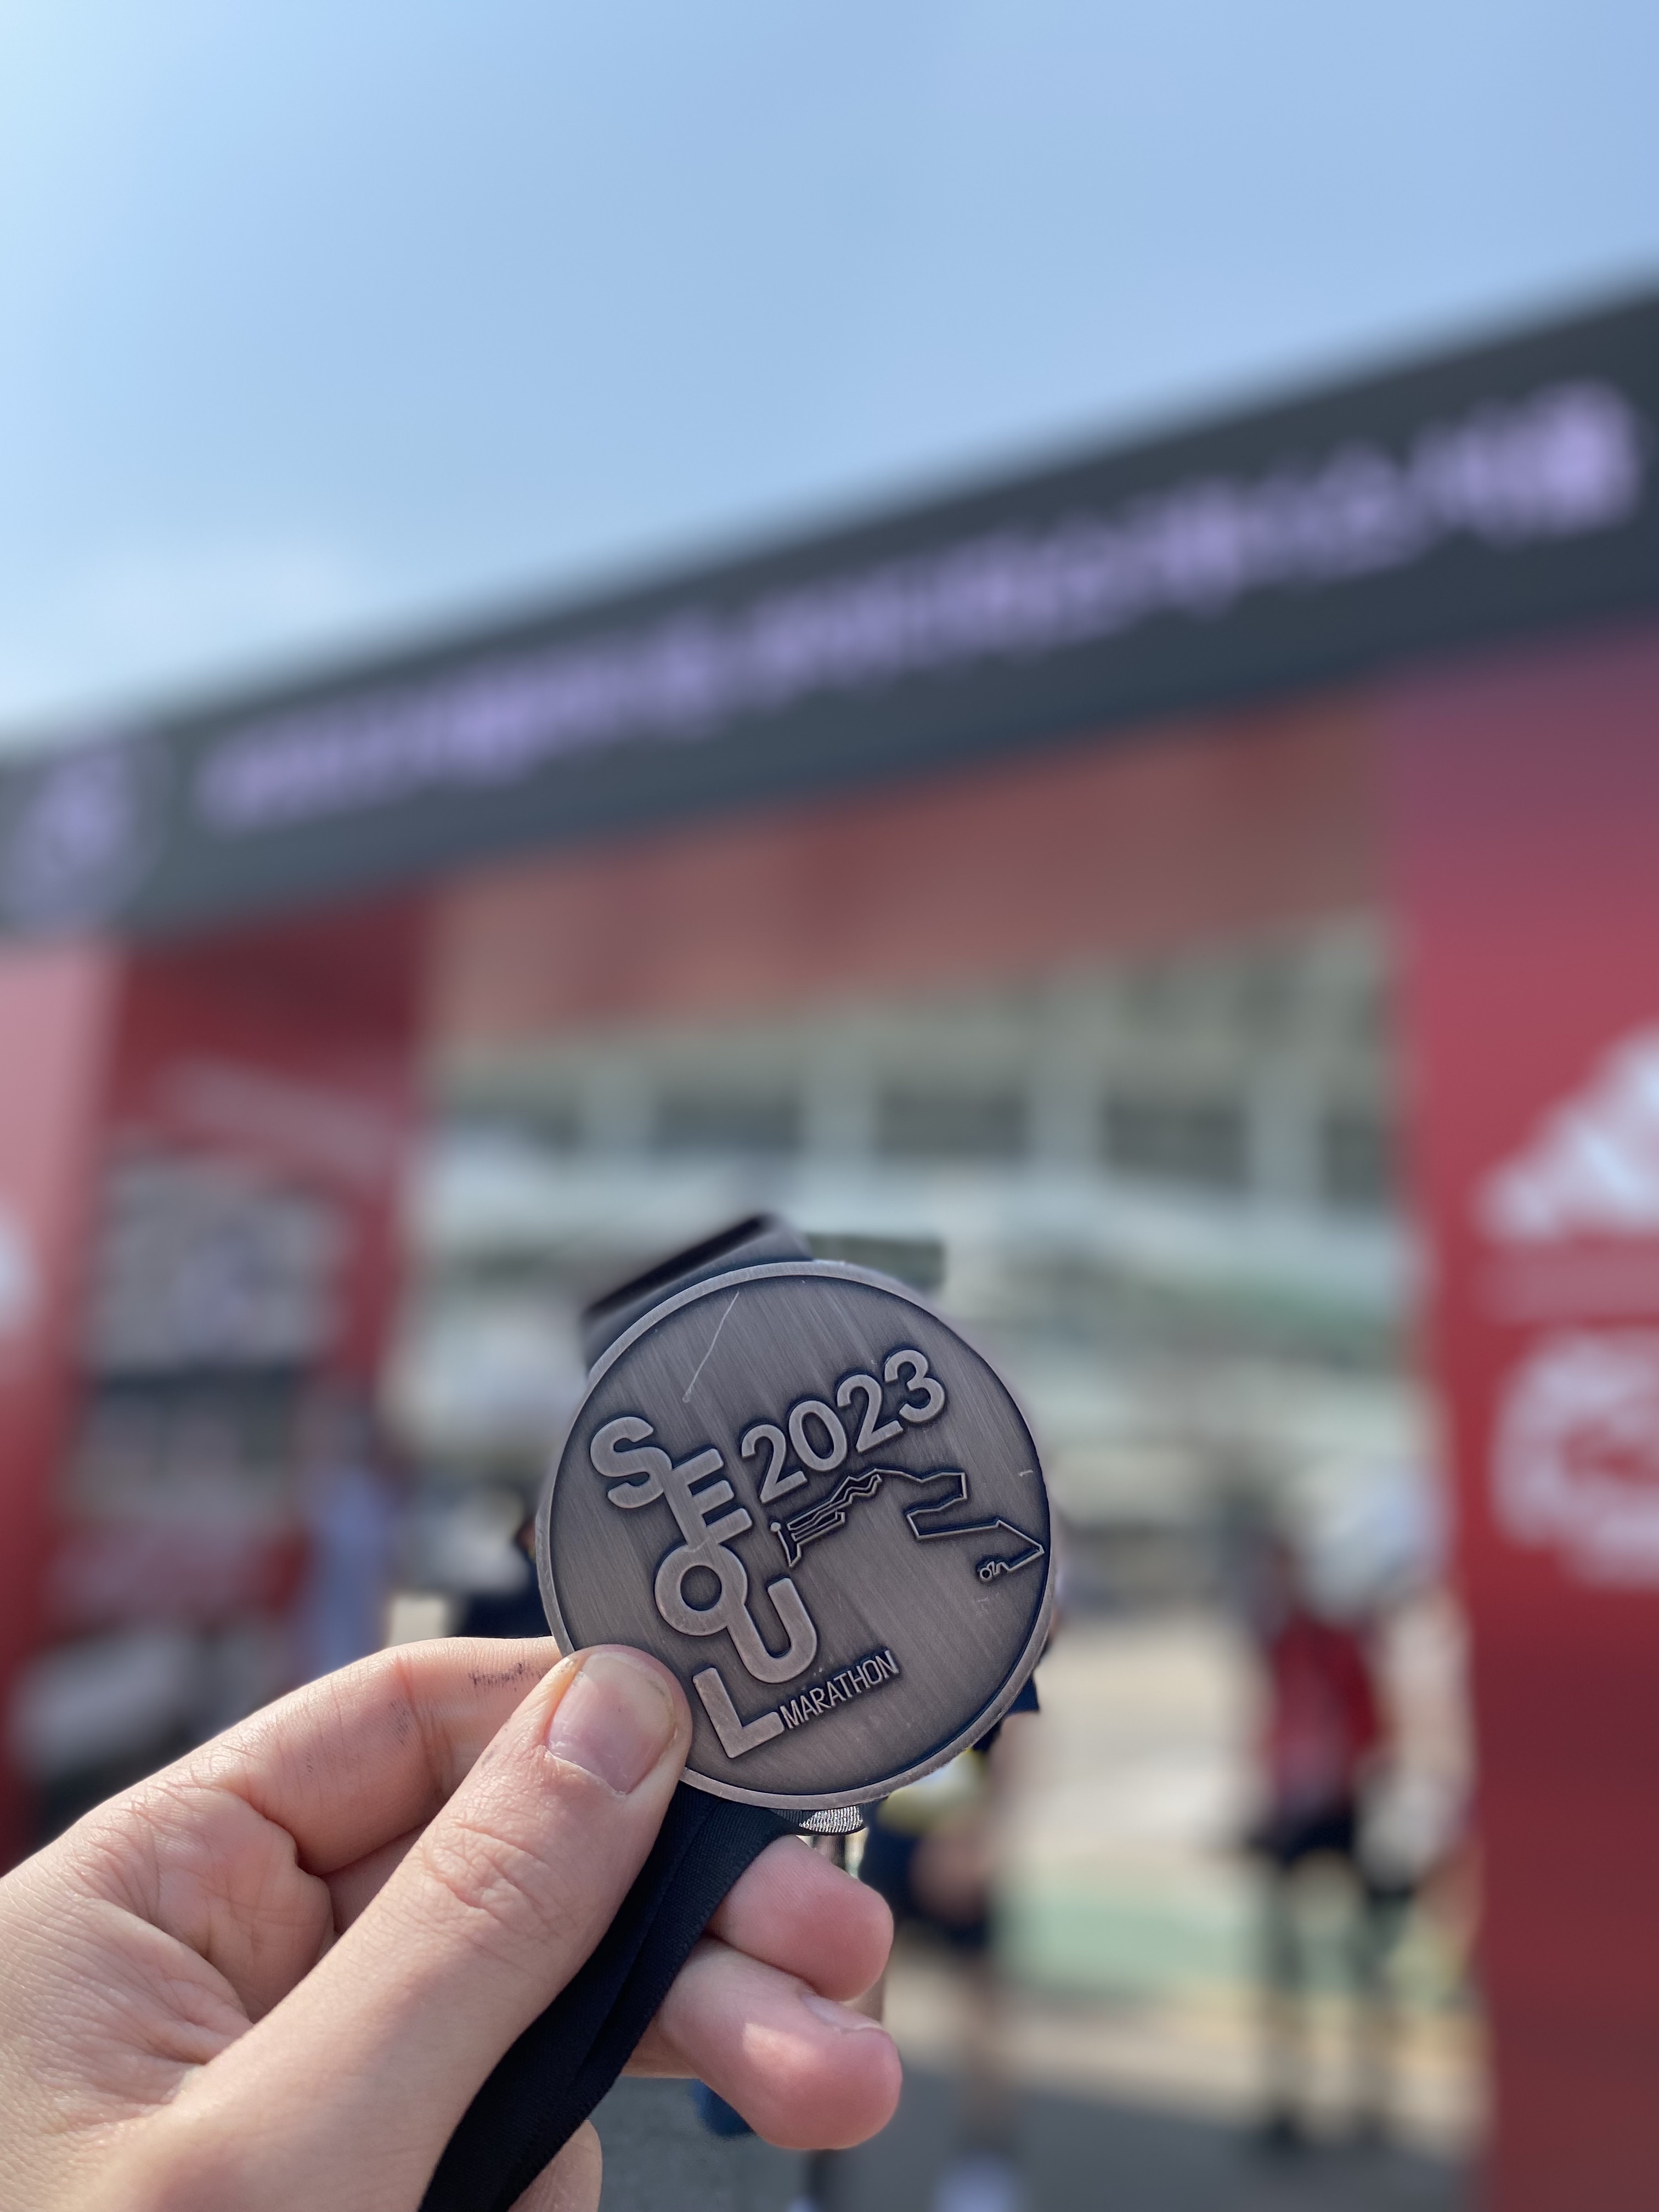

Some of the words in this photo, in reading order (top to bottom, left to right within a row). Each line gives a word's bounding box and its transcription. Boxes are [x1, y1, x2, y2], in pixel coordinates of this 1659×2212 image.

[741, 1348, 945, 1504] 2023
[590, 1415, 817, 1759] SEOUL
[779, 1649, 900, 1730] MARATHON
